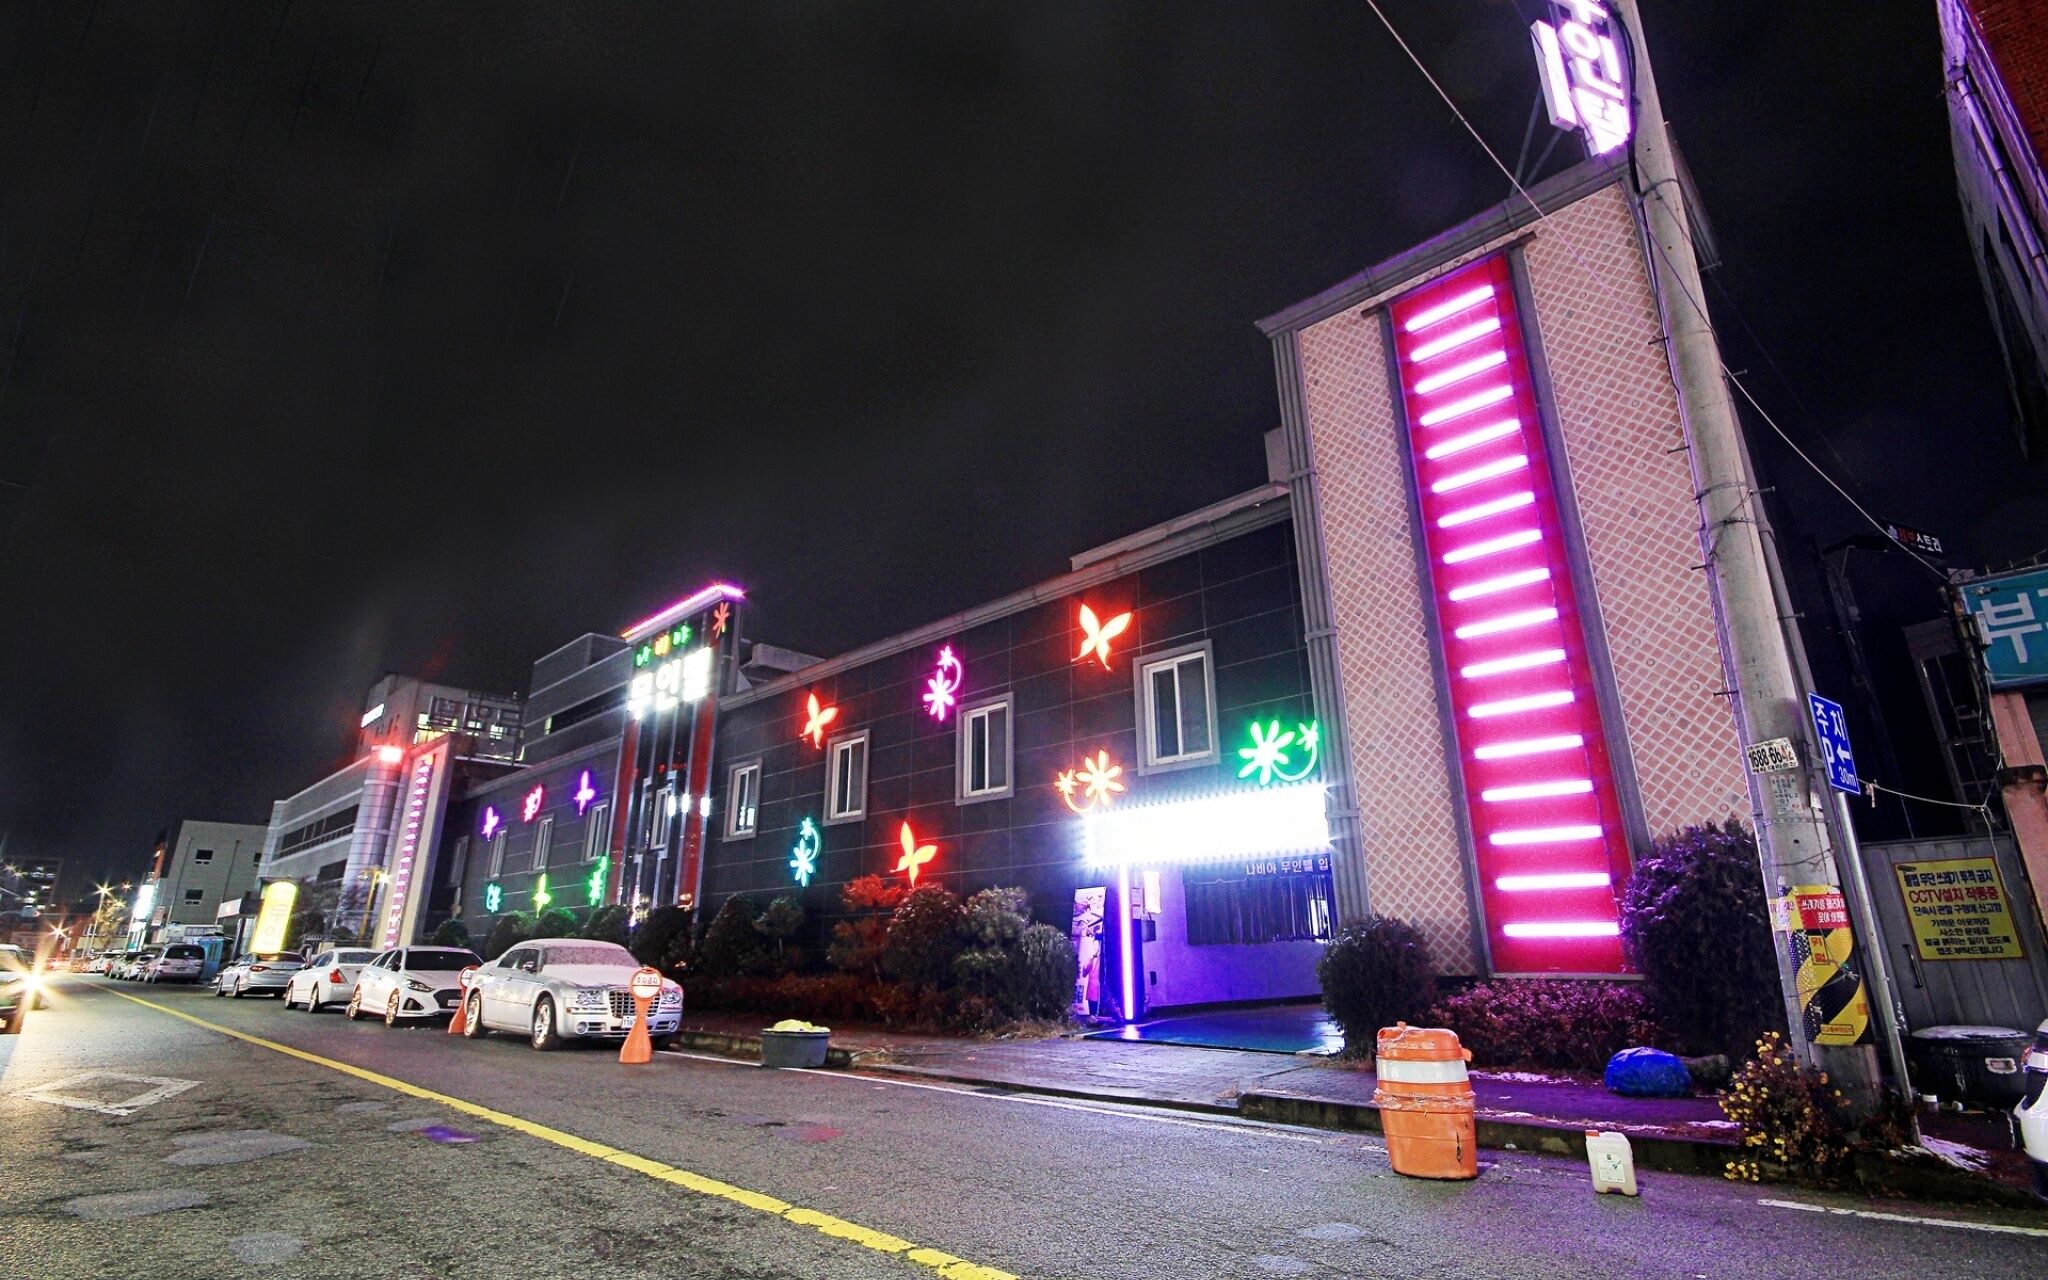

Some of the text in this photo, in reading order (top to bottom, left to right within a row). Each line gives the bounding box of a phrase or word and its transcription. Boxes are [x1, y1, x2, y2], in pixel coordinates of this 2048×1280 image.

[1980, 587, 2048, 664] 부
[628, 646, 712, 720] 무인텔
[1822, 736, 1836, 779] P
[1246, 857, 1332, 876] 나비아 무인텔 입
[1920, 872, 1936, 886] 무단
[1936, 871, 1960, 885] 쓰레기
[1976, 869, 1994, 883] 금지
[1908, 885, 2000, 904] CCTV설치 작동중
[1913, 905, 1936, 917] 단속시
